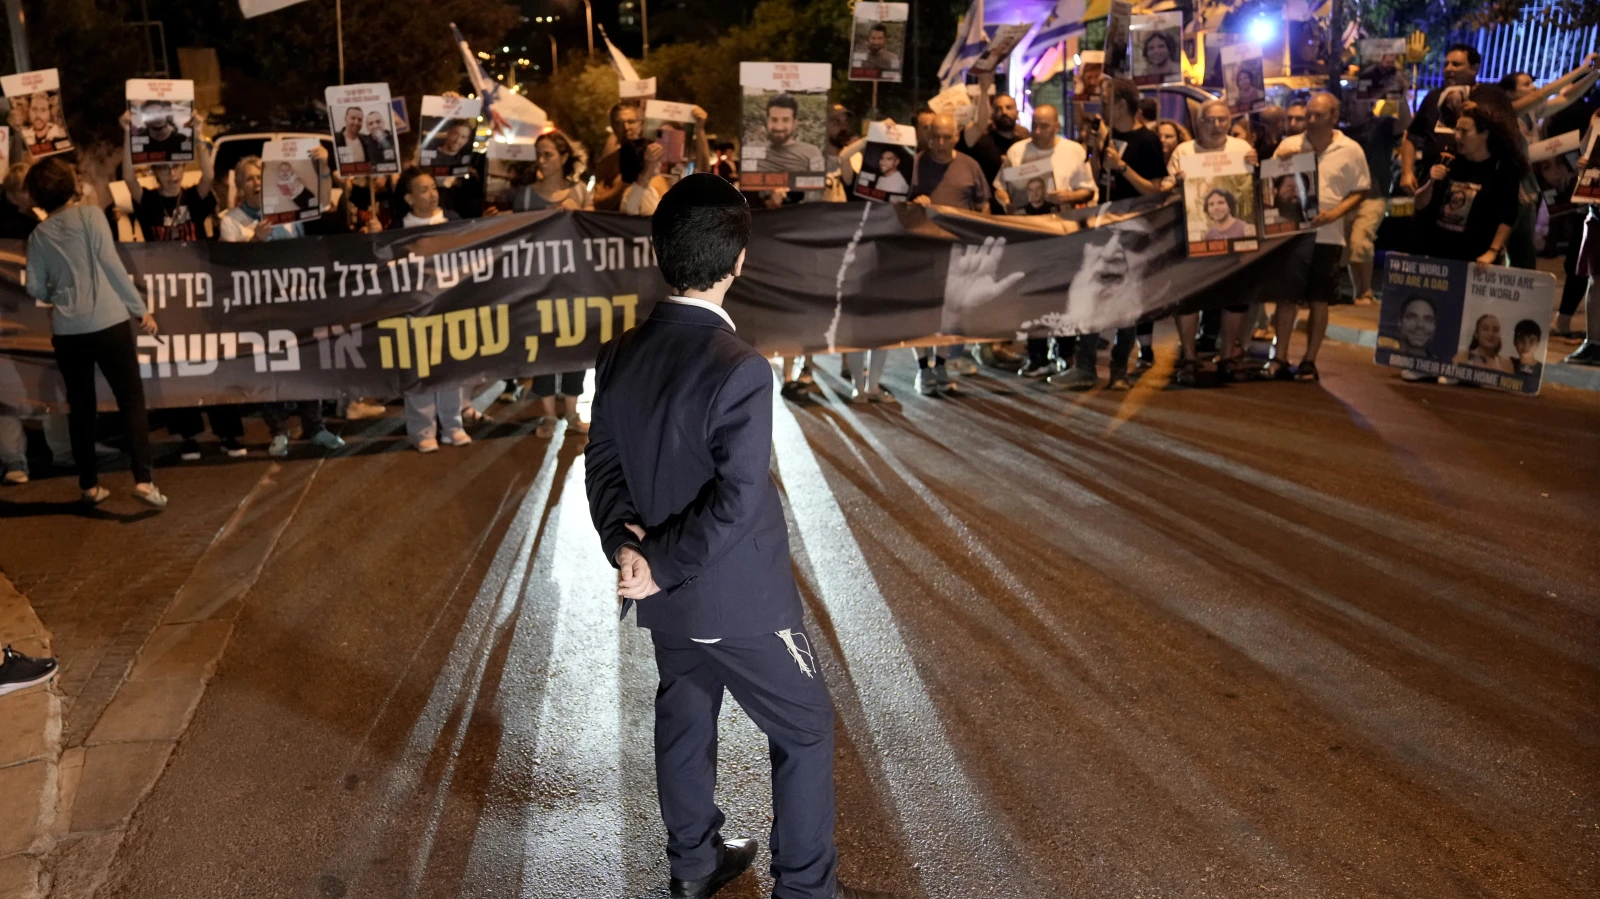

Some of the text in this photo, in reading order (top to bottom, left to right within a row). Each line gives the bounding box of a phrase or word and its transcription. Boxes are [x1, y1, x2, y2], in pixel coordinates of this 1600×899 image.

[387, 252, 426, 294] לנו
[433, 247, 496, 290] שיש
[502, 238, 577, 279] גדולה
[583, 237, 625, 272] הכי
[1402, 260, 1417, 273] THE
[1419, 263, 1449, 278] WORLD
[144, 271, 214, 314] פדיון
[223, 266, 327, 314] המצוות,
[333, 261, 382, 298] בכל
[1389, 272, 1449, 291] YOU ARE A DAD
[1471, 284, 1520, 302] THE WORLD
[1486, 271, 1497, 283] US
[1499, 273, 1515, 287] YOU
[1517, 276, 1534, 290] ARE
[136, 294, 639, 379] דרעי, עסקה או פרישה
[1389, 353, 1524, 391] BRING THEIR FATHER HOME NOW!
